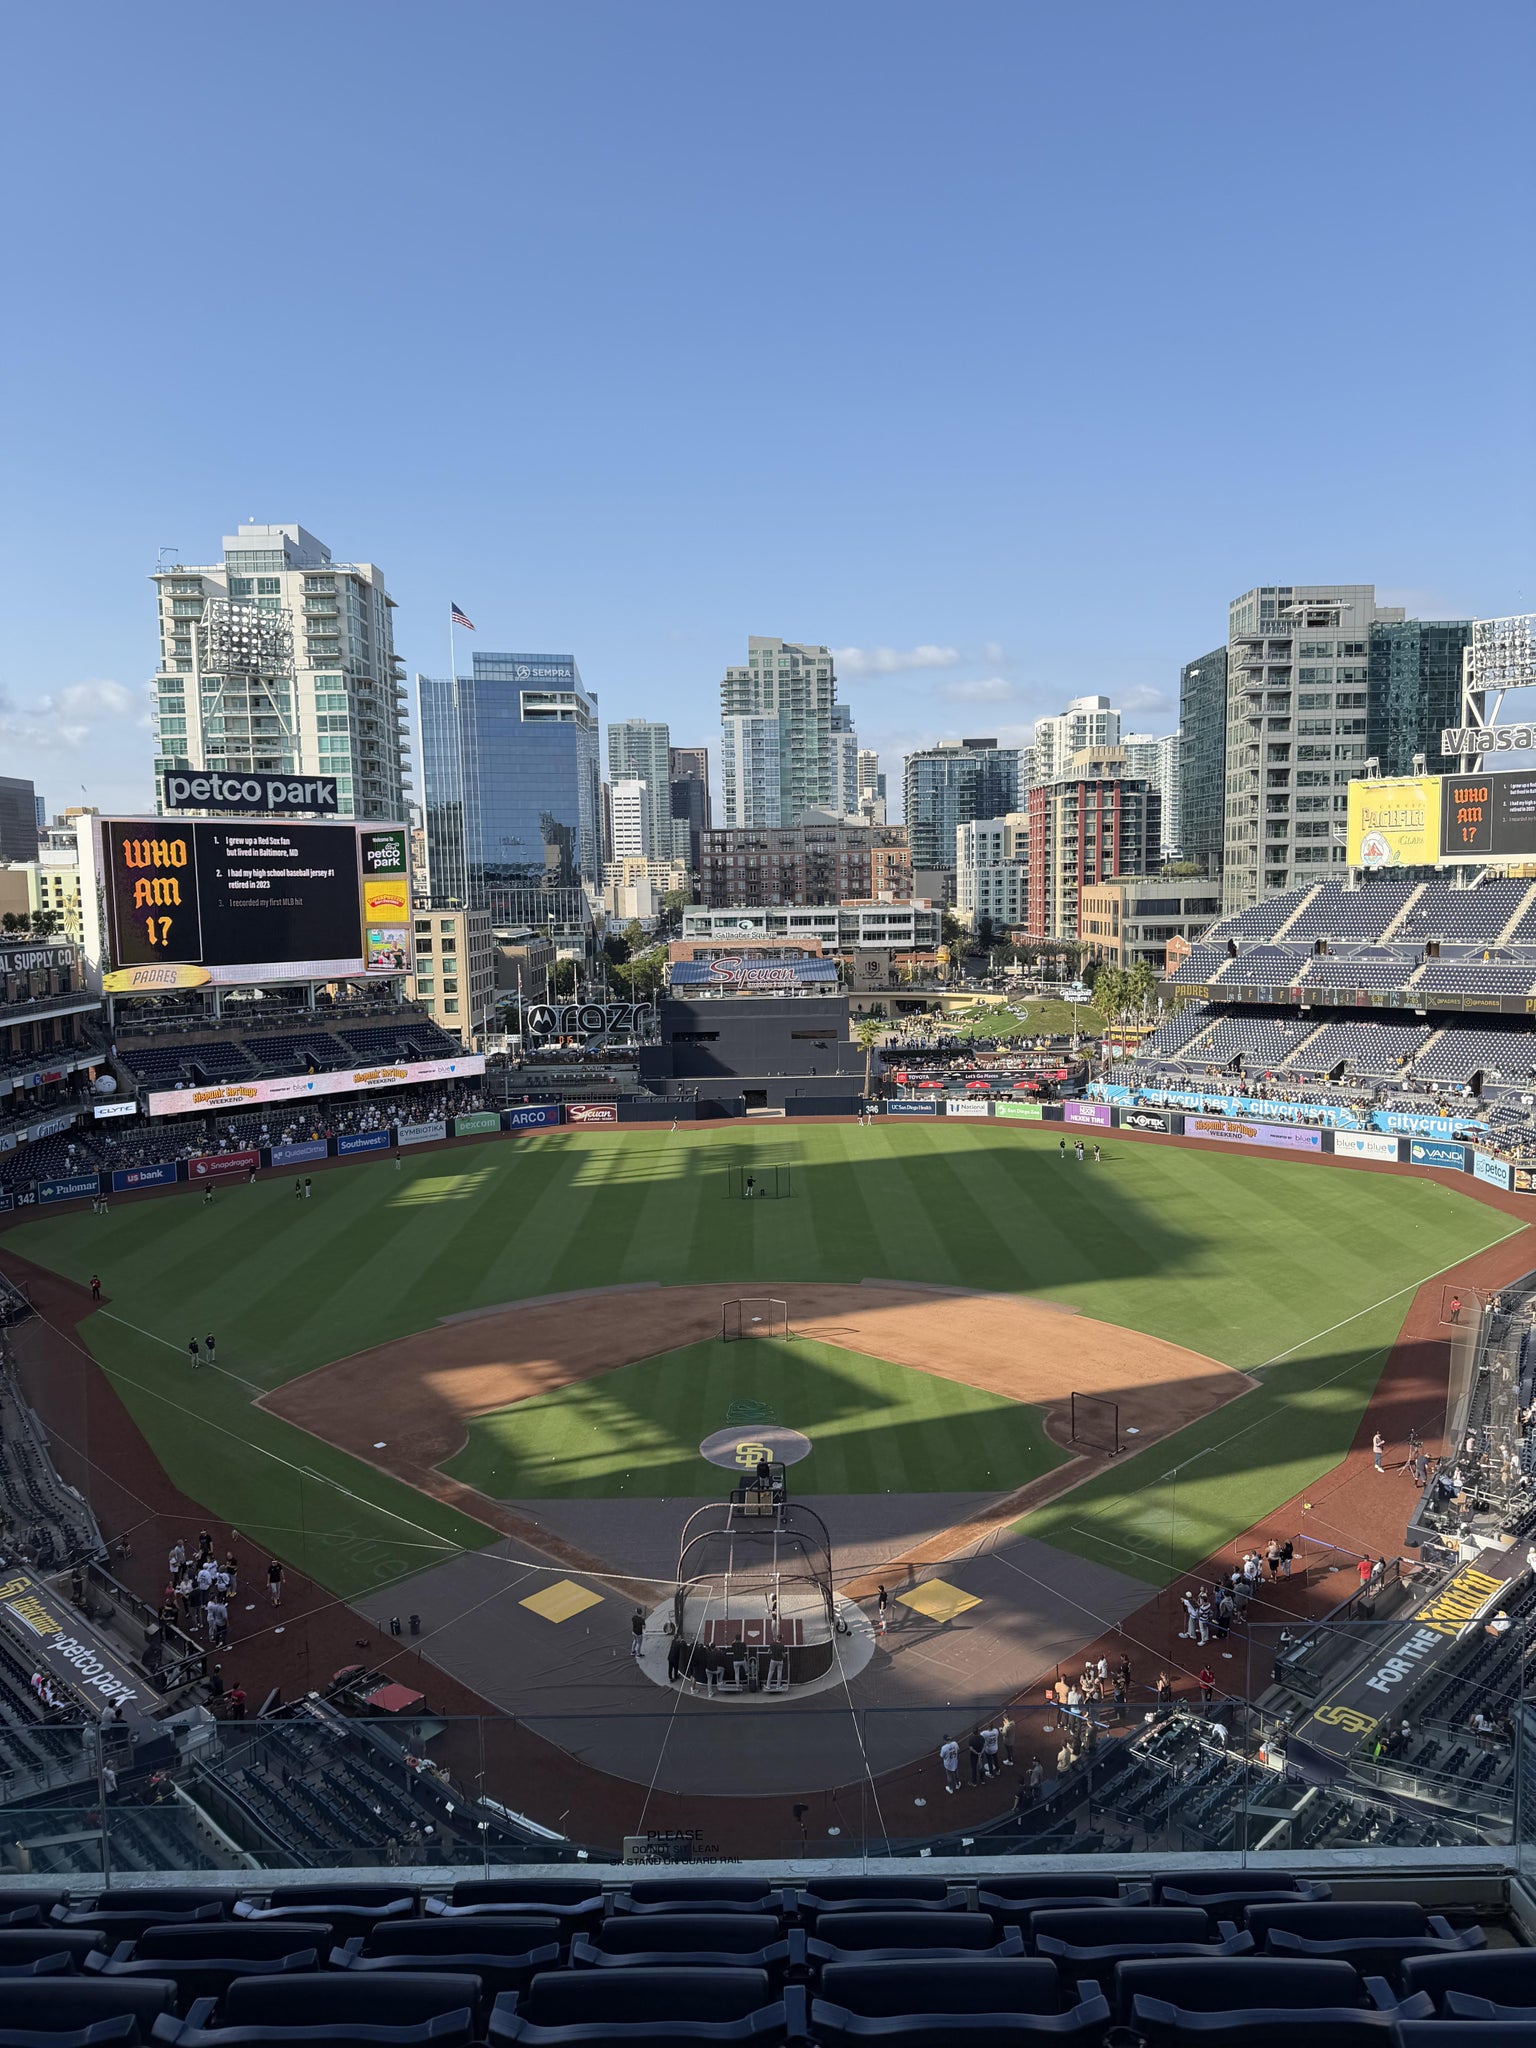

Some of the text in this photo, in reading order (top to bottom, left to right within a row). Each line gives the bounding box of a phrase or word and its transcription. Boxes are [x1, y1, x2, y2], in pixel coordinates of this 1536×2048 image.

[532, 668, 571, 677] SEMPRA
[1446, 728, 1536, 754] Viasa
[168, 774, 335, 809] petco park
[1454, 787, 1488, 804] WHO
[1457, 807, 1483, 824] AM
[229, 838, 244, 846] grew
[245, 838, 253, 846] up
[258, 837, 269, 845] Red
[270, 837, 280, 845] Sox
[280, 837, 290, 845] fan
[1462, 827, 1477, 843] I?
[122, 839, 187, 868] WHO
[226, 848, 237, 856] but
[237, 848, 252, 856] lived
[253, 848, 259, 856] in
[259, 848, 289, 857] Baltimore,
[368, 849, 400, 861] petco
[374, 857, 400, 869] park
[231, 869, 242, 877] had
[253, 869, 266, 878] high
[267, 869, 286, 877] school
[286, 869, 310, 877] baseball
[310, 869, 327, 878] jersey
[133, 878, 182, 909] AM
[233, 899, 259, 907] recorded
[260, 900, 269, 908] my
[146, 916, 172, 946] I?
[14, 949, 54, 971] SUPPLY
[58, 949, 75, 966] CO.
[868, 961, 878, 971] 19
[132, 970, 178, 985] PADRES
[709, 956, 798, 989] Sycuan
[1175, 985, 1209, 998] PADRES
[561, 1002, 652, 1033] razr
[353, 1068, 408, 1084] Hispanic Heritage
[193, 1086, 257, 1104] Hispanic Heritage
[209, 1096, 243, 1105] WEEKEND
[1151, 1091, 1229, 1109] citycruises
[512, 1112, 546, 1124] ARCO
[570, 1106, 612, 1121] Sycuan
[1070, 1115, 1091, 1123] NEXEN
[1127, 1115, 1164, 1126] EVOTEK
[38, 1119, 65, 1138] Canel's
[400, 1125, 444, 1137] CYMBIOTIKA
[1195, 1120, 1257, 1137] Hispanic Heritage
[1209, 1130, 1243, 1139] WEEKEND
[341, 1137, 381, 1149] Southwest
[1295, 1134, 1311, 1142] blue
[285, 1146, 325, 1157] QuidelOrtho
[1337, 1139, 1387, 1151] blue blue
[210, 1158, 253, 1169] Snapdragon
[127, 1170, 163, 1182] us bank
[1485, 1164, 1507, 1178] petco
[56, 1182, 97, 1194] Palomar
[18, 1192, 35, 1206] 342
[735, 1442, 774, 1468] SD
[10, 1596, 138, 1707] Welcome petco park
[1314, 1705, 1378, 1734] SD
[1366, 1657, 1415, 1694] FOR
[1396, 1628, 1443, 1660] THE
[647, 1830, 704, 1841] PLEASE
[632, 1845, 719, 1854] DO NOT SIT LEAN
